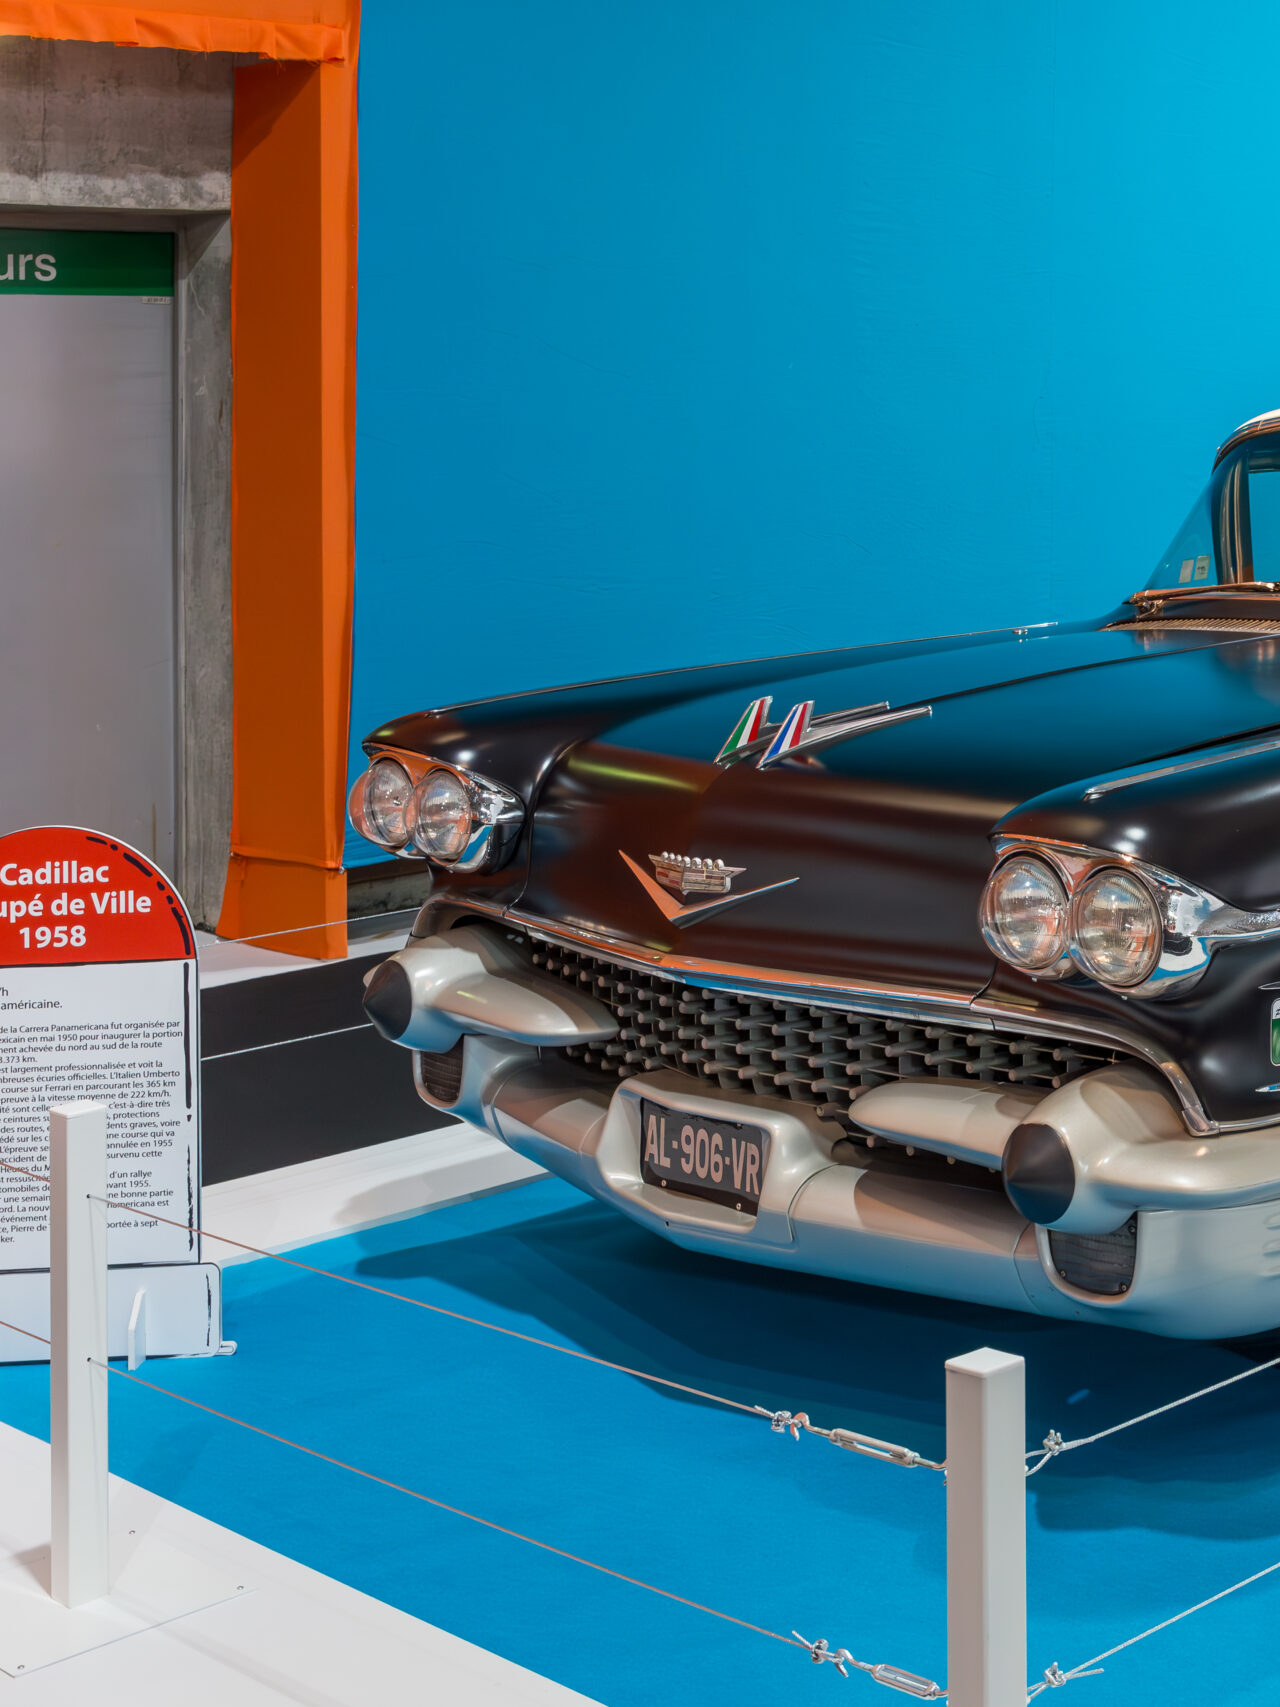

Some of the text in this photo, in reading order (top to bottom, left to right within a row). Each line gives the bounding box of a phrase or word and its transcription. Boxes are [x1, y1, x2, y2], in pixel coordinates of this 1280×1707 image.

[0, 860, 110, 886] Cadillac
[51, 892, 85, 916] de
[91, 890, 152, 914] Ville
[19, 925, 87, 949] 1958
[0, 1000, 63, 1011] américaine.
[10, 1025, 18, 1033] la
[19, 1025, 49, 1033] Carrera
[51, 1022, 109, 1032] Panamericana
[110, 1021, 123, 1030] fut
[124, 1020, 165, 1031] organisée
[166, 1021, 180, 1030] par
[40, 1034, 56, 1042] mai
[58, 1033, 78, 1042] 1950
[79, 1034, 99, 1043] pour
[101, 1032, 141, 1042] inaugurer
[143, 1031, 151, 1039] la
[152, 1029, 183, 1039] portion
[19, 1044, 53, 1054] achevée
[55, 1043, 66, 1052] du
[68, 1043, 88, 1051] nord
[102, 1042, 117, 1050] sud
[118, 1041, 130, 1049] de
[131, 1041, 139, 1049] la
[140, 1041, 163, 1049] route
[22, 1055, 38, 1063] km.
[10, 1065, 53, 1074] largement
[55, 1061, 126, 1073] professionnalisée
[127, 1061, 137, 1069] et
[138, 1060, 154, 1069] voit
[155, 1060, 163, 1068] la
[0, 1070, 180, 1084] breuses écuries officielles. L'Italien Umberto
[1, 1086, 29, 1094] course
[30, 1085, 43, 1093] sur
[45, 1083, 72, 1092] Ferrari
[85, 1082, 131, 1092] parcourant
[132, 1081, 144, 1089] les
[146, 1080, 161, 1088] 365
[163, 1080, 176, 1088] km
[31, 1094, 37, 1103] à
[38, 1094, 46, 1102] la
[47, 1093, 76, 1102] vitesse
[77, 1093, 117, 1102] moyenne
[118, 1090, 129, 1099] de
[130, 1090, 146, 1099] 222
[147, 1089, 172, 1099] km/h.
[12, 1105, 31, 1113] sont
[155, 1099, 171, 1108] très
[2, 1115, 41, 1124] ceintures
[112, 1110, 160, 1121] protections
[0, 1126, 15, 1134] des
[17, 1125, 45, 1133] routes,
[129, 1120, 159, 1130] graves,
[160, 1119, 181, 1128] voire
[31, 1134, 43, 1143] les
[120, 1131, 149, 1139] course
[150, 1129, 164, 1139] qui
[165, 1130, 175, 1138] va
[140, 1140, 151, 1148] en
[153, 1139, 173, 1148] 1955
[36, 1154, 48, 1162] de
[106, 1150, 140, 1159] survenu
[141, 1149, 163, 1158] cette
[644, 1114, 760, 1196] AL-906-VR
[31, 1163, 43, 1173] du
[109, 1169, 153, 1179] d'un rallye
[129, 1179, 152, 1189] 1955.
[120, 1190, 148, 1199] bonne
[149, 1188, 174, 1198] partie
[16, 1204, 27, 1213] La
[156, 1199, 169, 1207] est
[0, 1214, 48, 1224] événement
[10, 1224, 35, 1233] Pierre
[36, 1223, 48, 1232] de
[133, 1219, 139, 1228] à
[140, 1219, 159, 1229] sept
